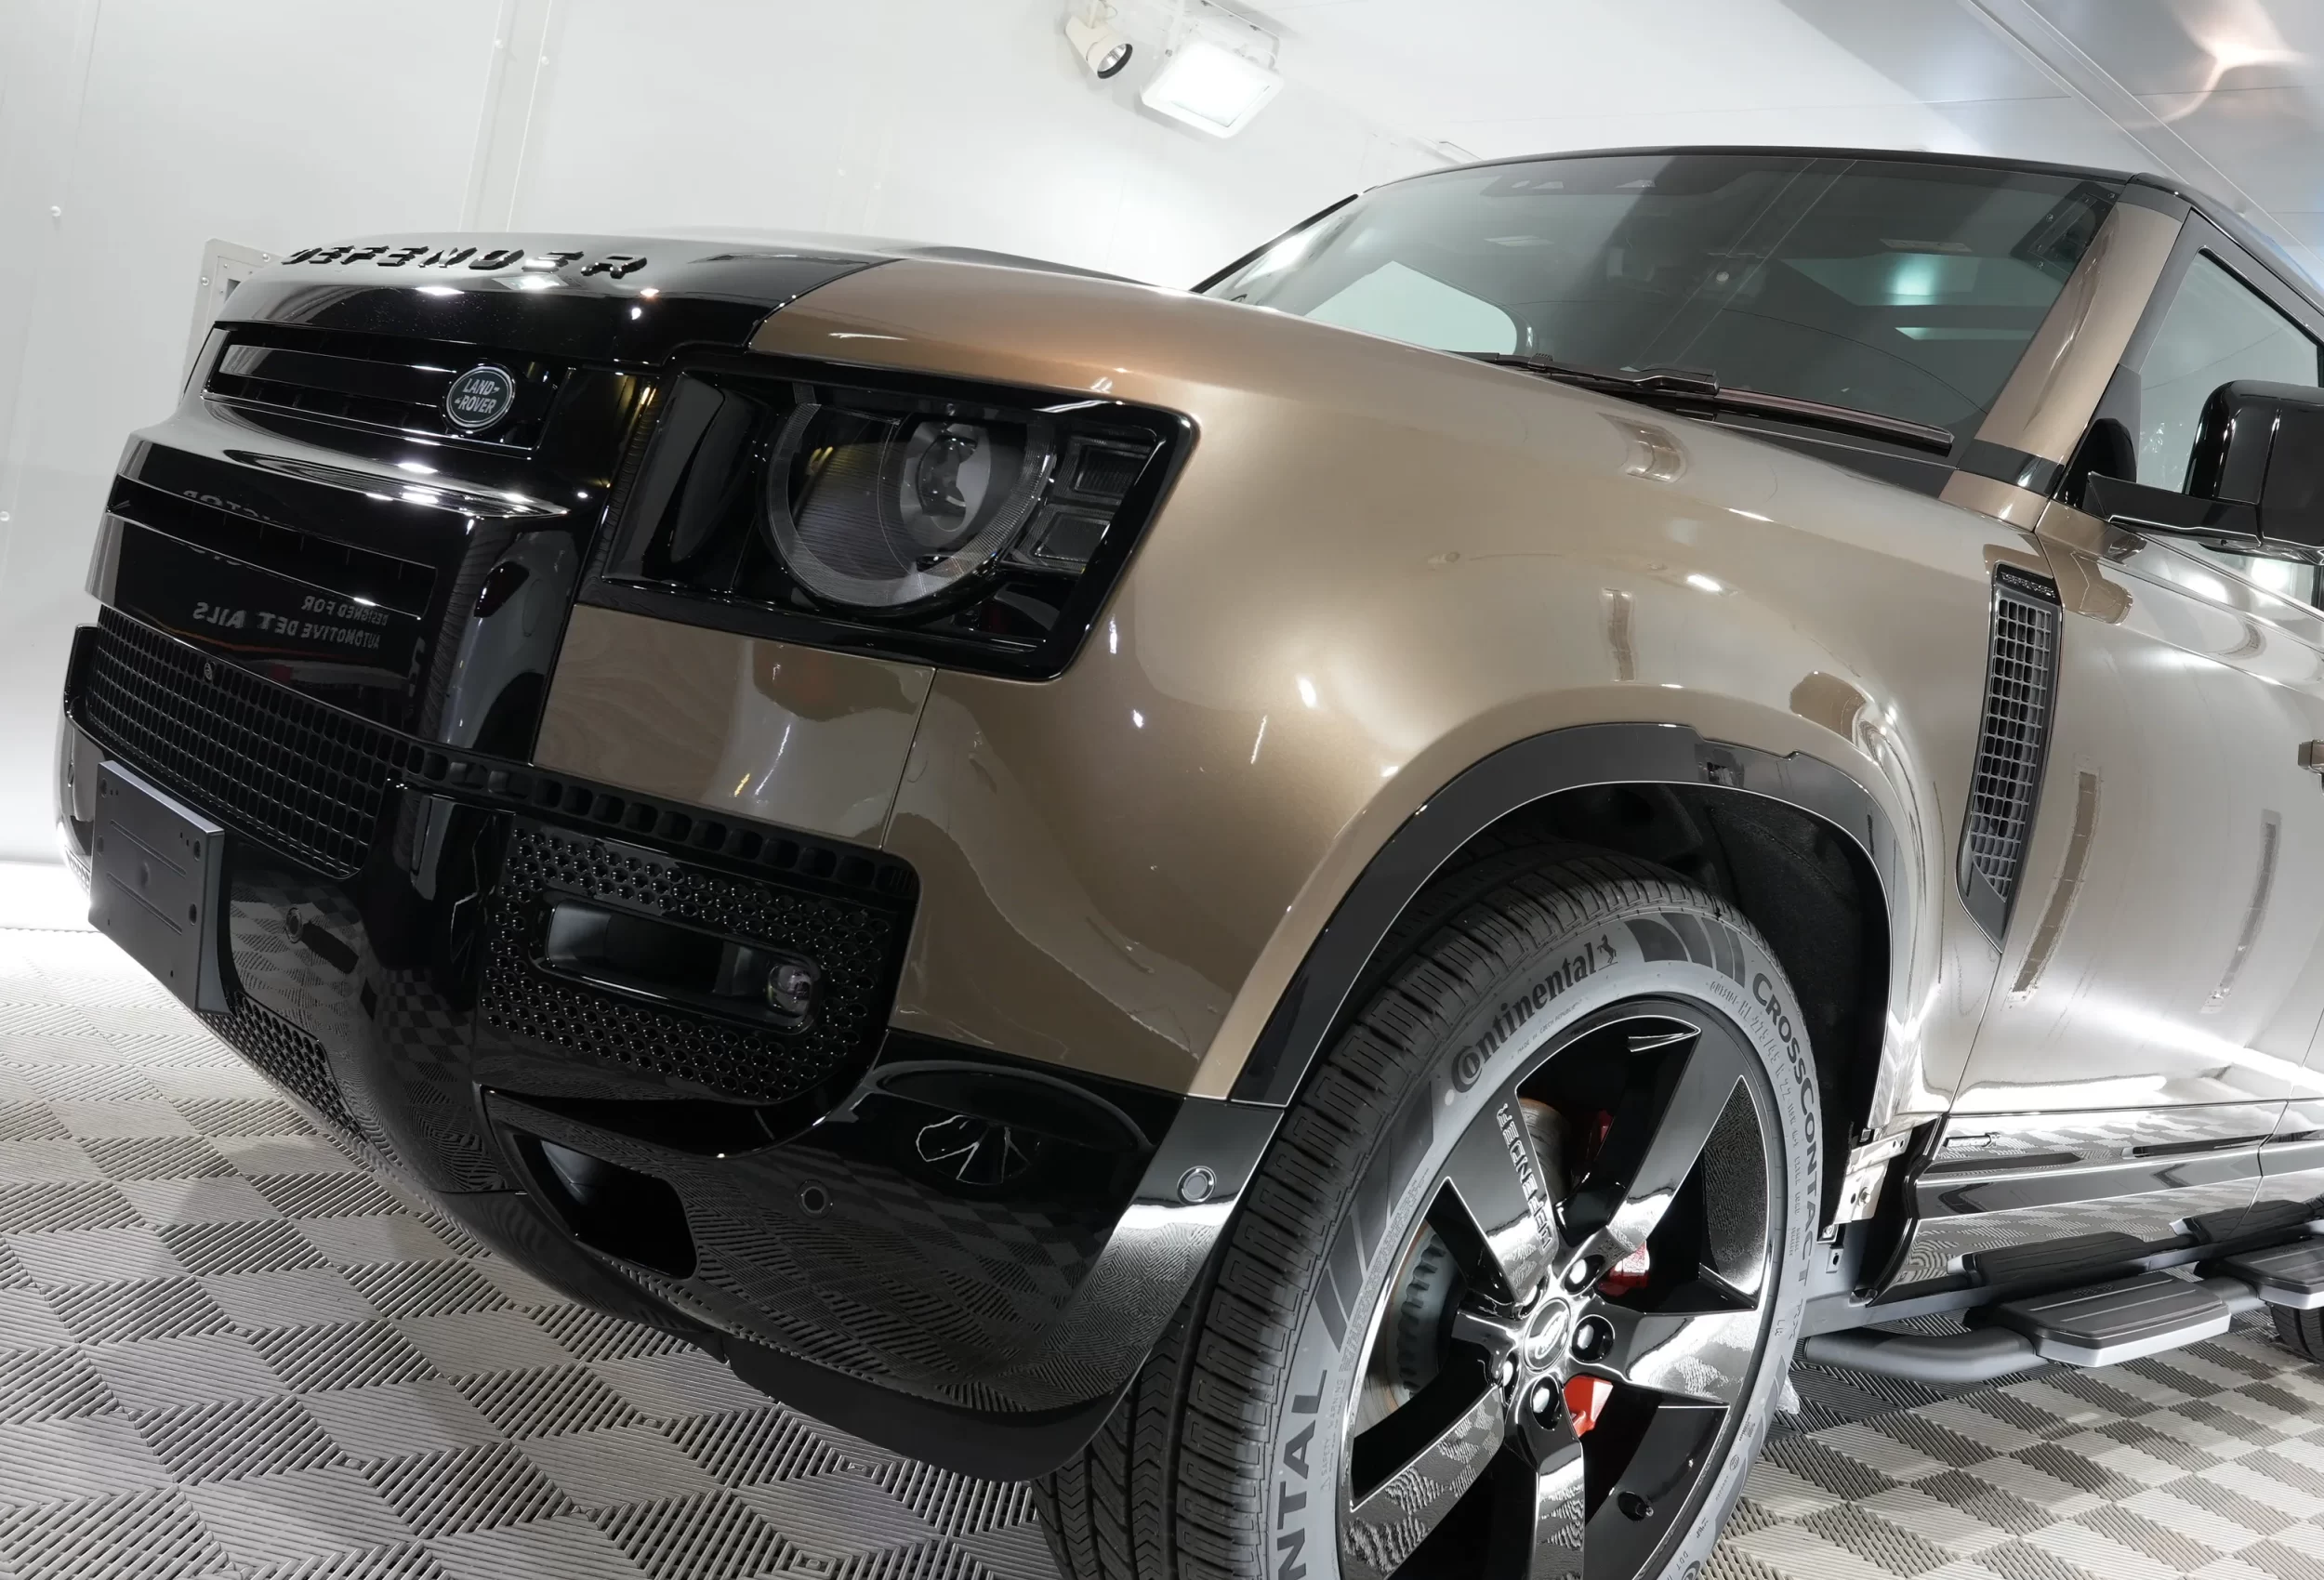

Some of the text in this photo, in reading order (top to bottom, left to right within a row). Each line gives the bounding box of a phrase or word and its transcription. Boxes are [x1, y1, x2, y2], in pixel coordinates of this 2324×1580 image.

[280, 244, 648, 280] DEFENDER
[462, 377, 495, 396] LAND
[459, 395, 497, 415] ROVER
[1451, 941, 1597, 1093] Continental
[1496, 1102, 1553, 1251] DEFENDER
